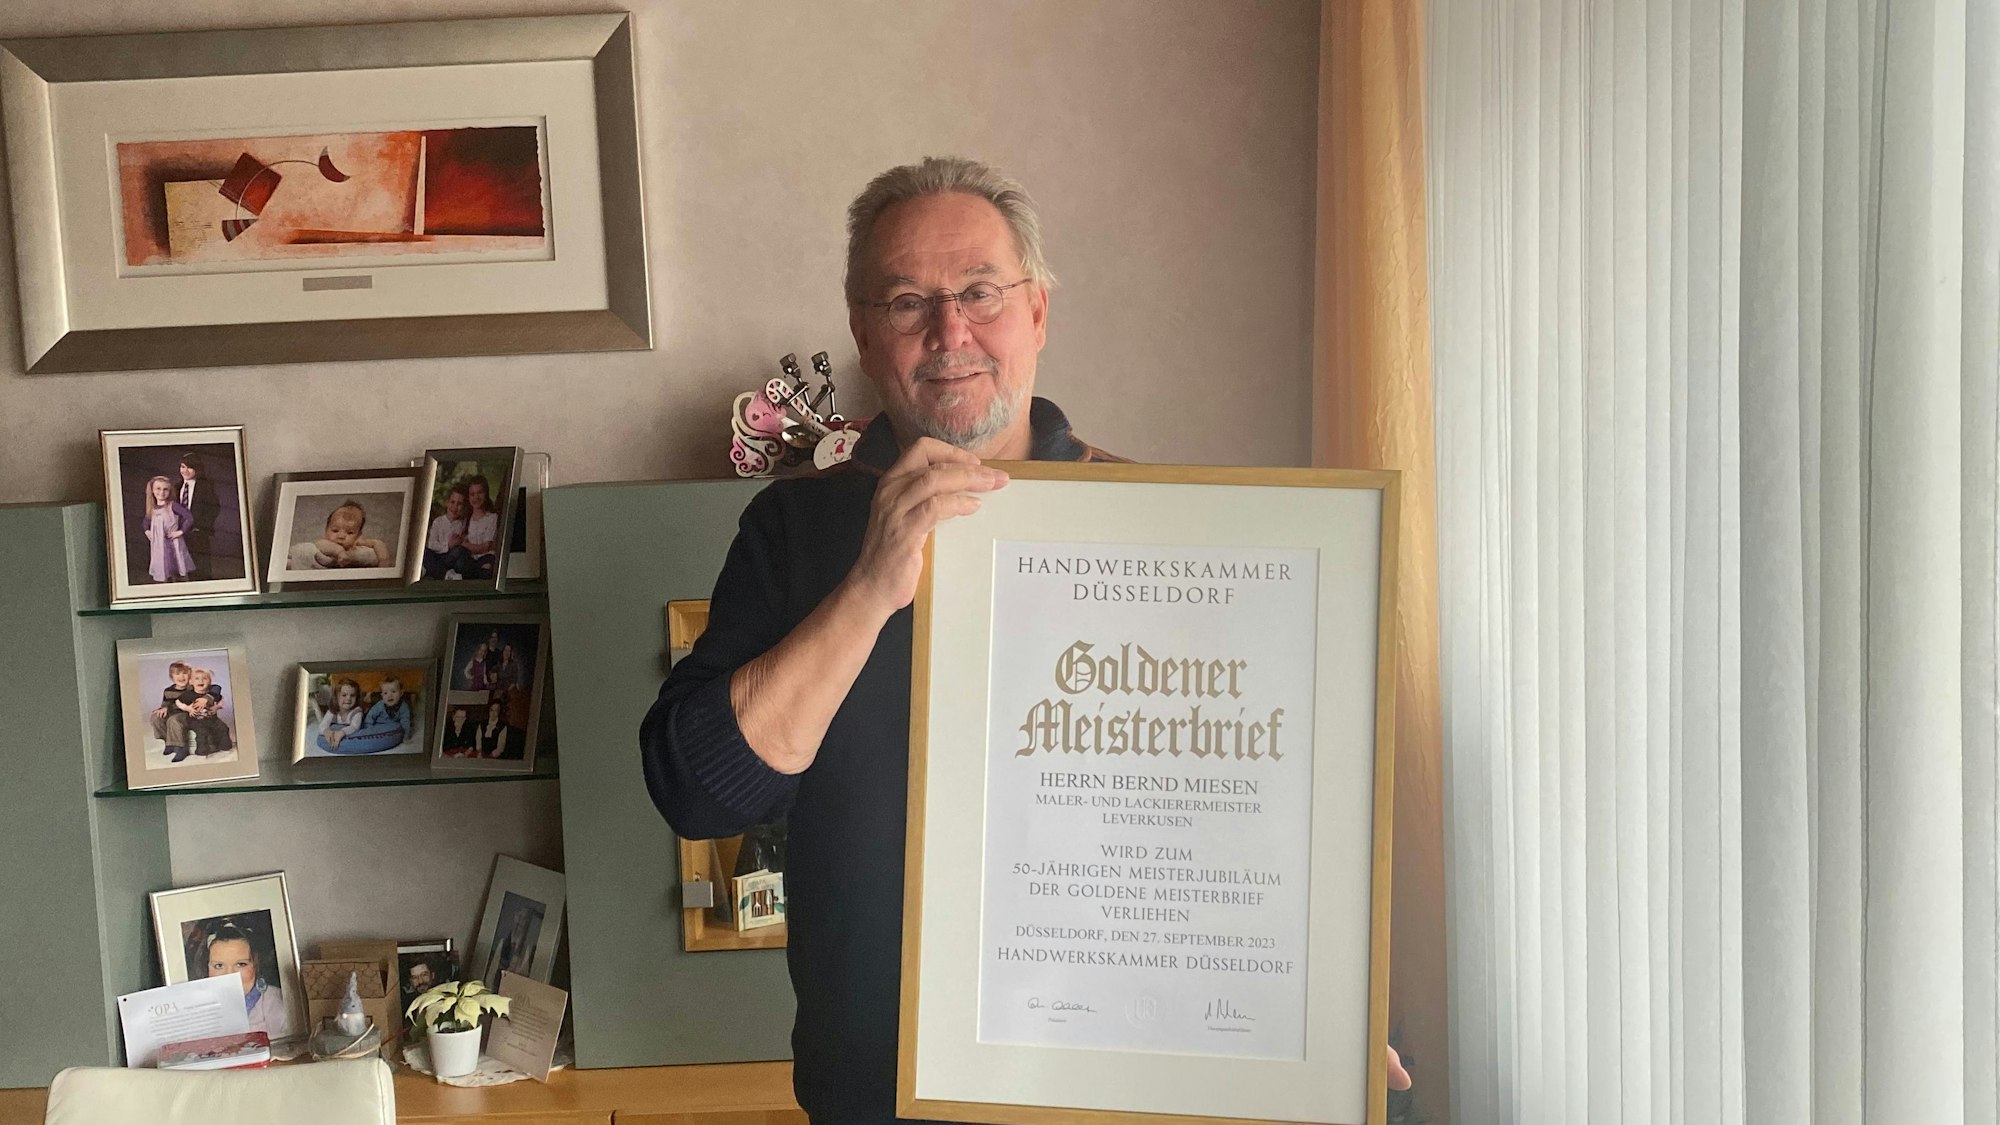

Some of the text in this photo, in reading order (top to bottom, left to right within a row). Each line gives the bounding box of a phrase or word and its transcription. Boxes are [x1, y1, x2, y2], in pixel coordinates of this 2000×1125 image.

[1018, 556, 1291, 580] HANDWERKSKAMMER
[1073, 581, 1234, 604] DÜSSELDORF
[1055, 640, 1247, 699] Goldener
[1015, 698, 1284, 762] Meisterbrief
[1040, 772, 1258, 795] HERRN BERND MIESEN
[1036, 793, 1262, 813] MALER- UND LACKIERERMEISTER
[1103, 813, 1192, 827] LEVERKUSEN
[1100, 844, 1192, 861] WIRD ZUM
[1012, 860, 1280, 885] 50-JÄHRIGEN MEISTERJUBILÄUM
[1030, 882, 1264, 905] DER GOLDENE MEISTERBRIEF
[1101, 905, 1190, 922] VERLIEHEN
[1016, 924, 1275, 948] DÜSSELDORF, DEN 27. SEPTEMBER 2023
[998, 947, 1293, 974] HANDWERKSKAMMER DÜSSELDORF
